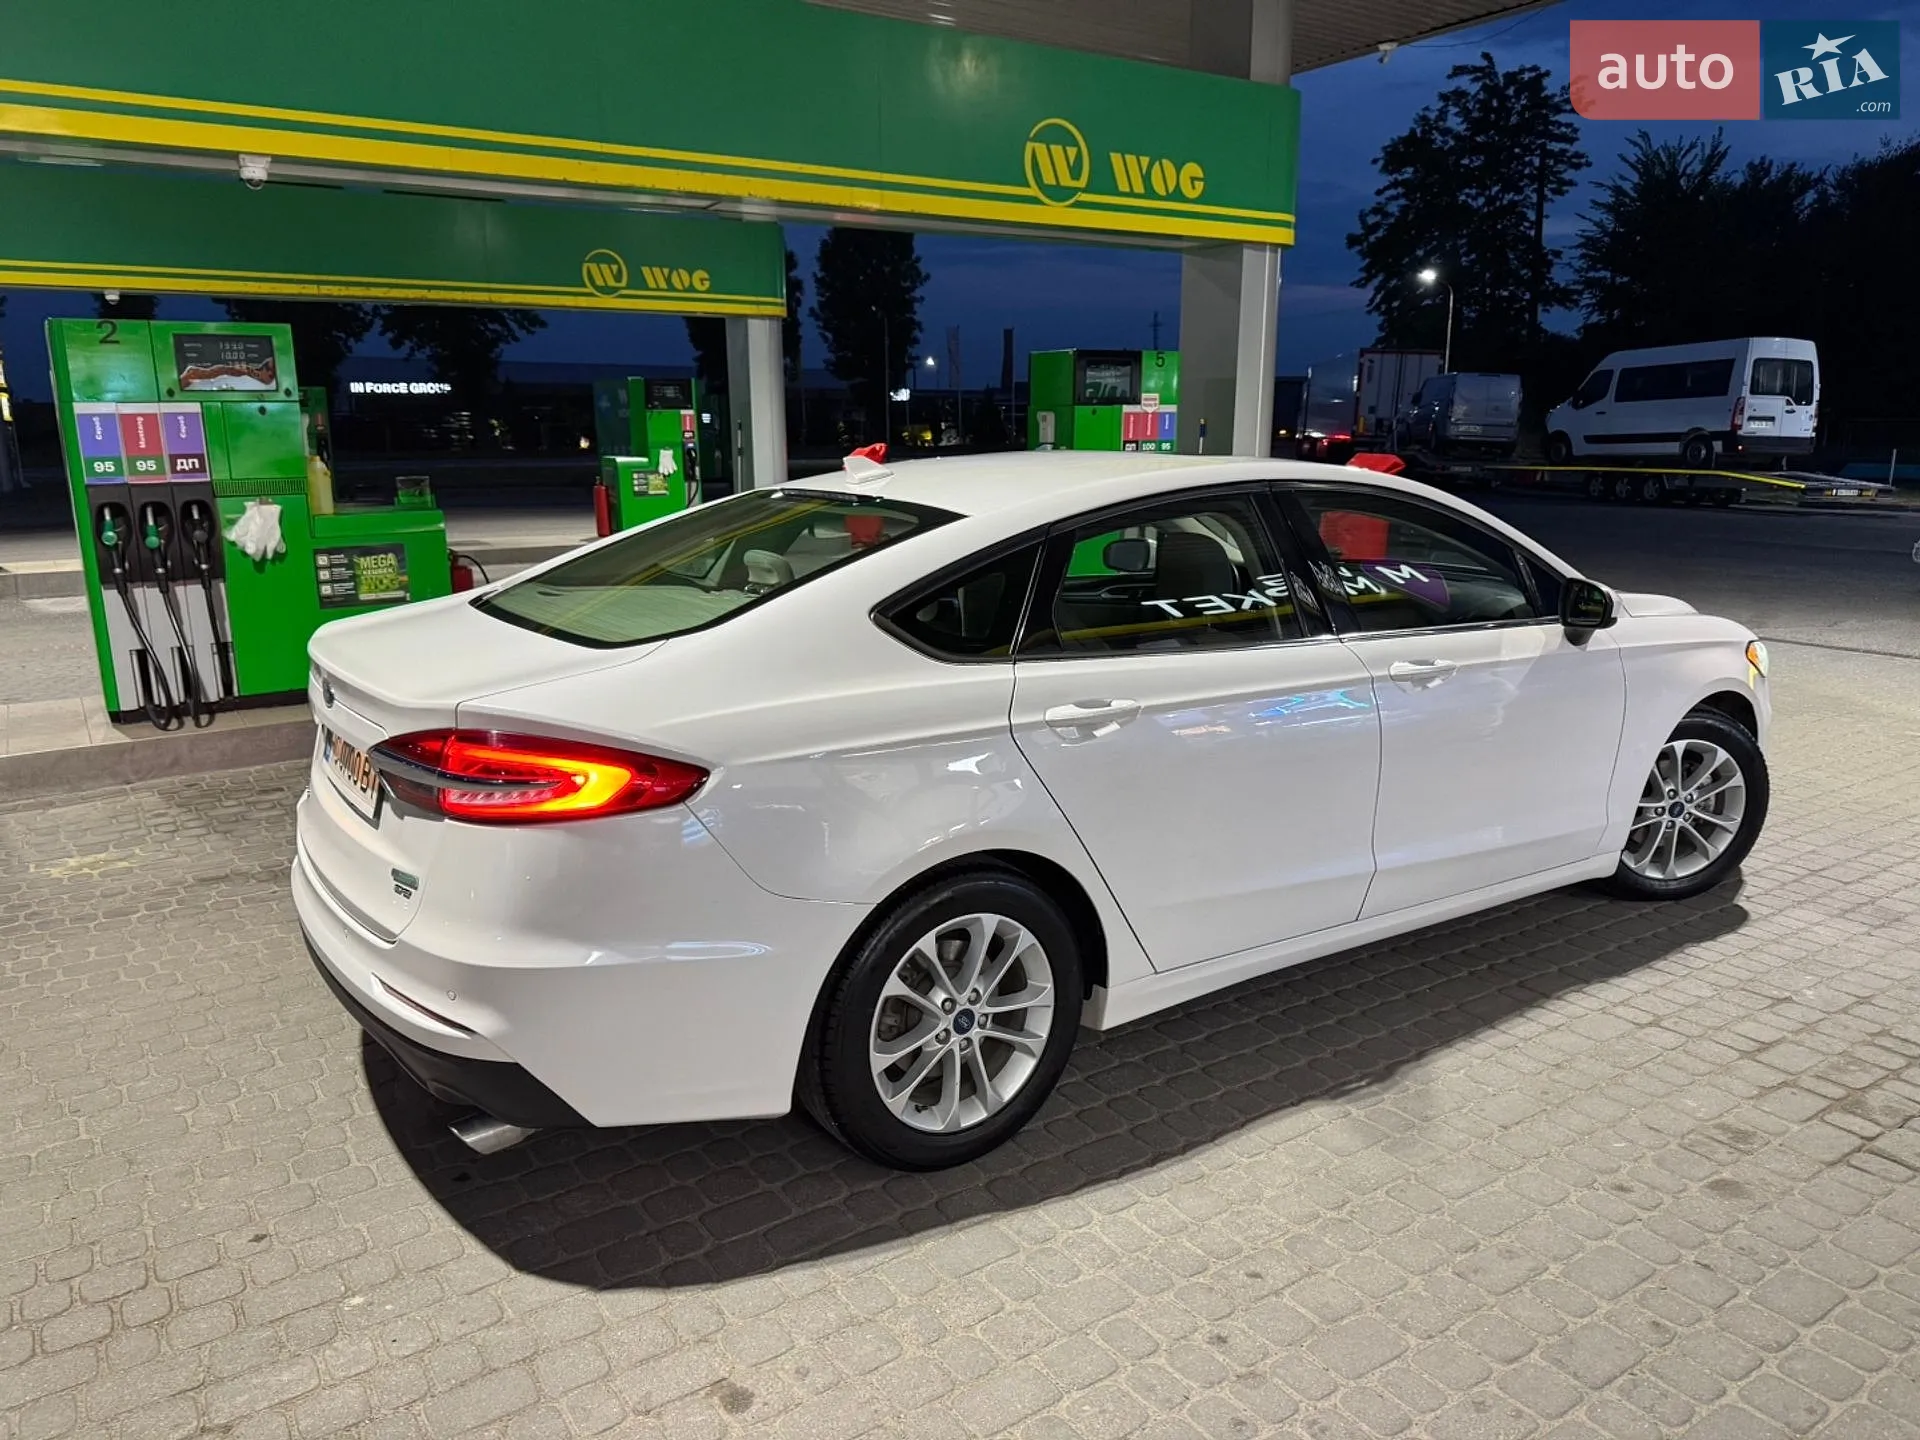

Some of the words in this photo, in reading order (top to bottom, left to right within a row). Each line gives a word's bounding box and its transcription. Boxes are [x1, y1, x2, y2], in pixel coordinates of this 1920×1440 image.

[1109, 152, 1205, 199] WOG
[640, 265, 711, 292] WOG
[96, 319, 120, 345] 2
[1155, 351, 1166, 368] 5
[350, 382, 364, 394] IN
[365, 382, 409, 394] FORCE
[93, 461, 116, 473] 95
[135, 460, 157, 472] 95
[176, 458, 200, 472] ДП
[360, 553, 397, 569] MEGA
